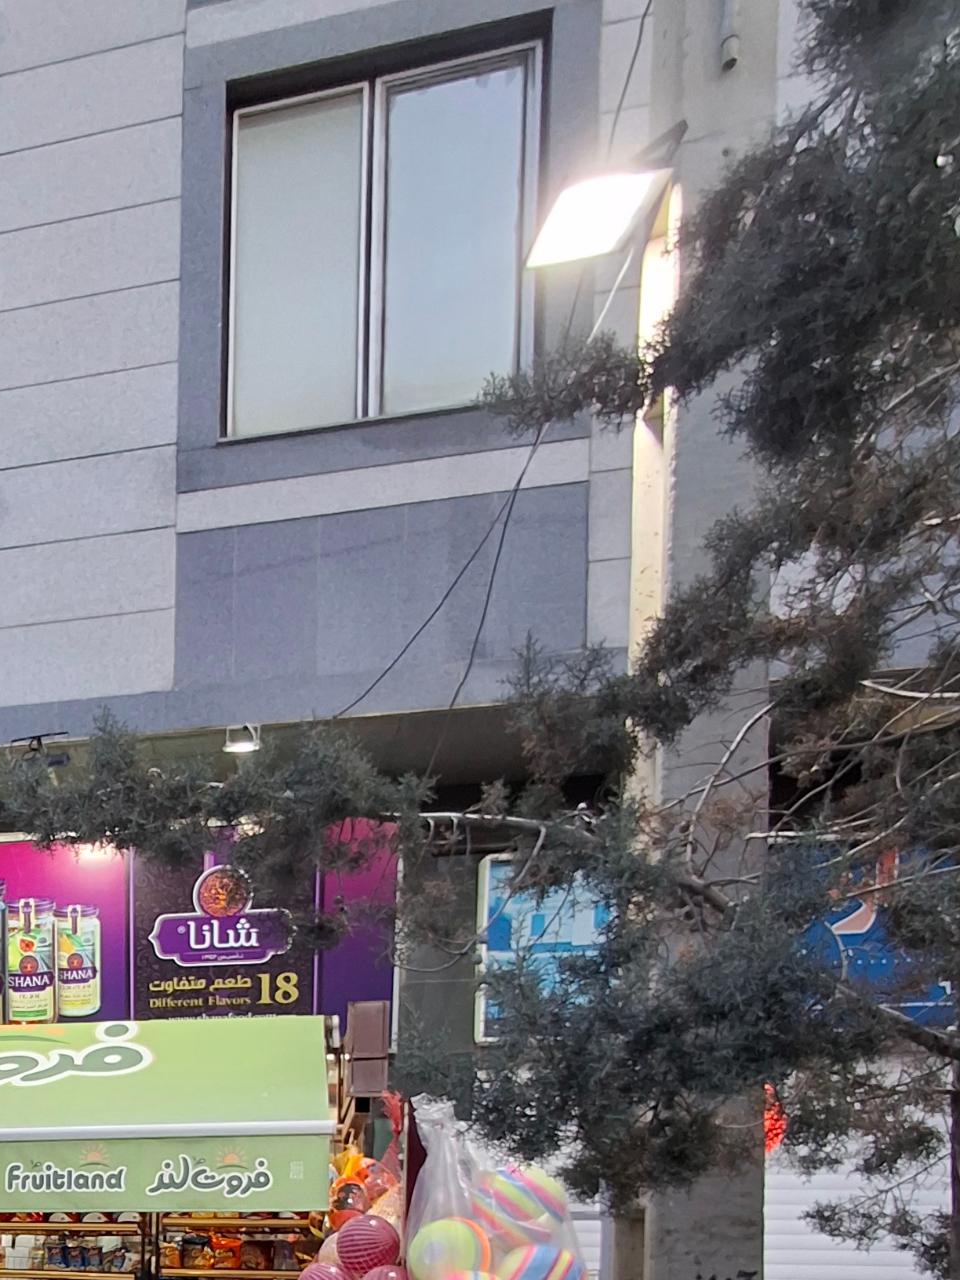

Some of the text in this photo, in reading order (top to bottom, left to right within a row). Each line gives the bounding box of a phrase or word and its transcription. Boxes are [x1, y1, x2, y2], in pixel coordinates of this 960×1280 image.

[187, 918, 260, 949] شانا
[7, 974, 50, 988] SHANA
[149, 975, 252, 994] طعم متفاوت
[256, 972, 299, 1005] 18
[149, 995, 252, 1009] Different Flavors
[5, 1162, 125, 1193] Fruitland
